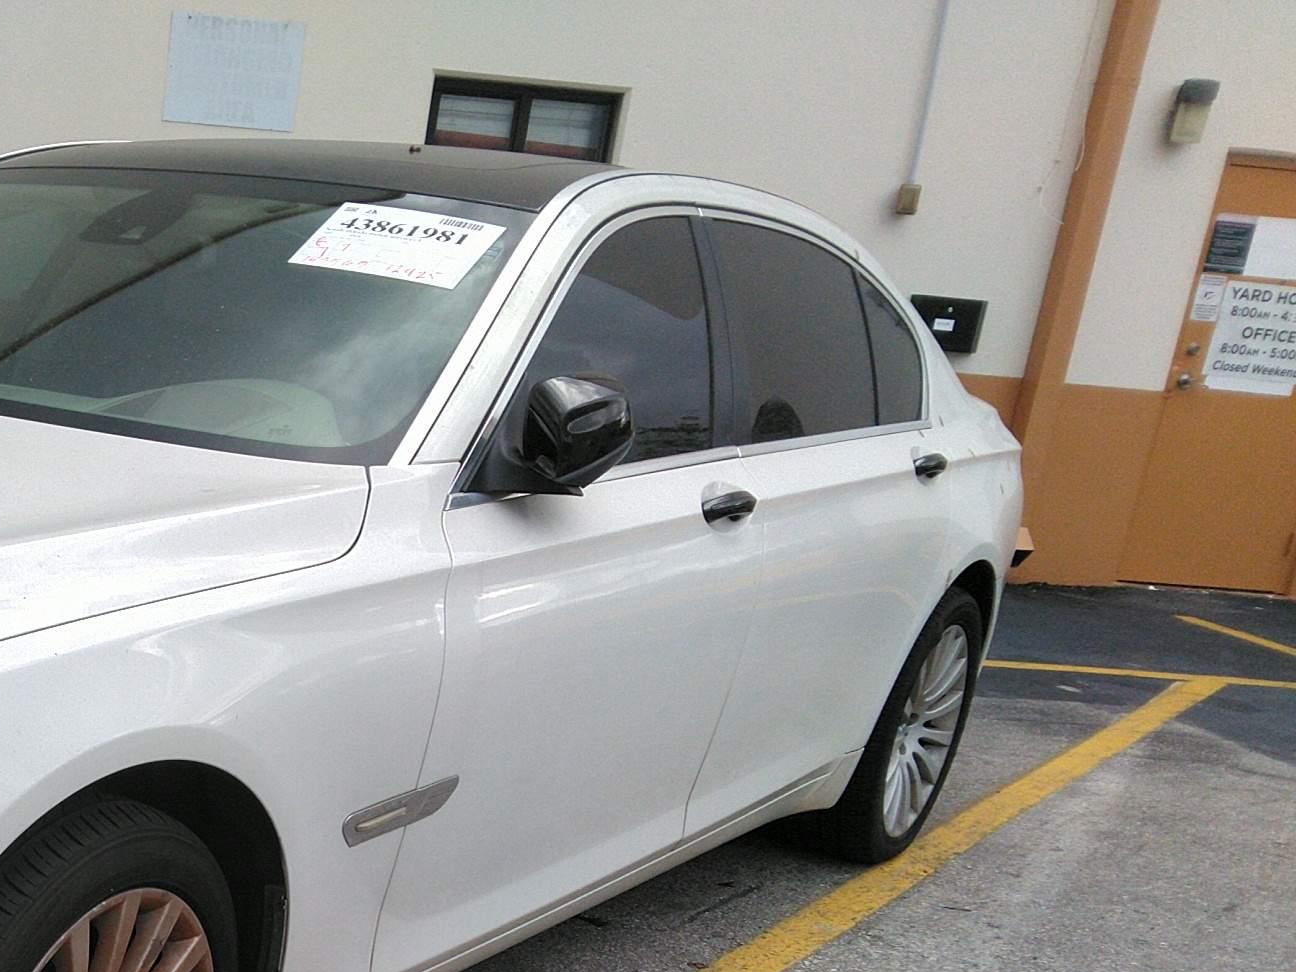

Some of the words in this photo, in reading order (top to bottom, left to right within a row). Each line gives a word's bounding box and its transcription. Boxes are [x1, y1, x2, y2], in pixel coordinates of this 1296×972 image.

[340, 217, 470, 246] 43861981
[1232, 287, 1273, 302] YARD
[1242, 326, 1296, 343] OFFICE
[1212, 360, 1250, 373] Closed
